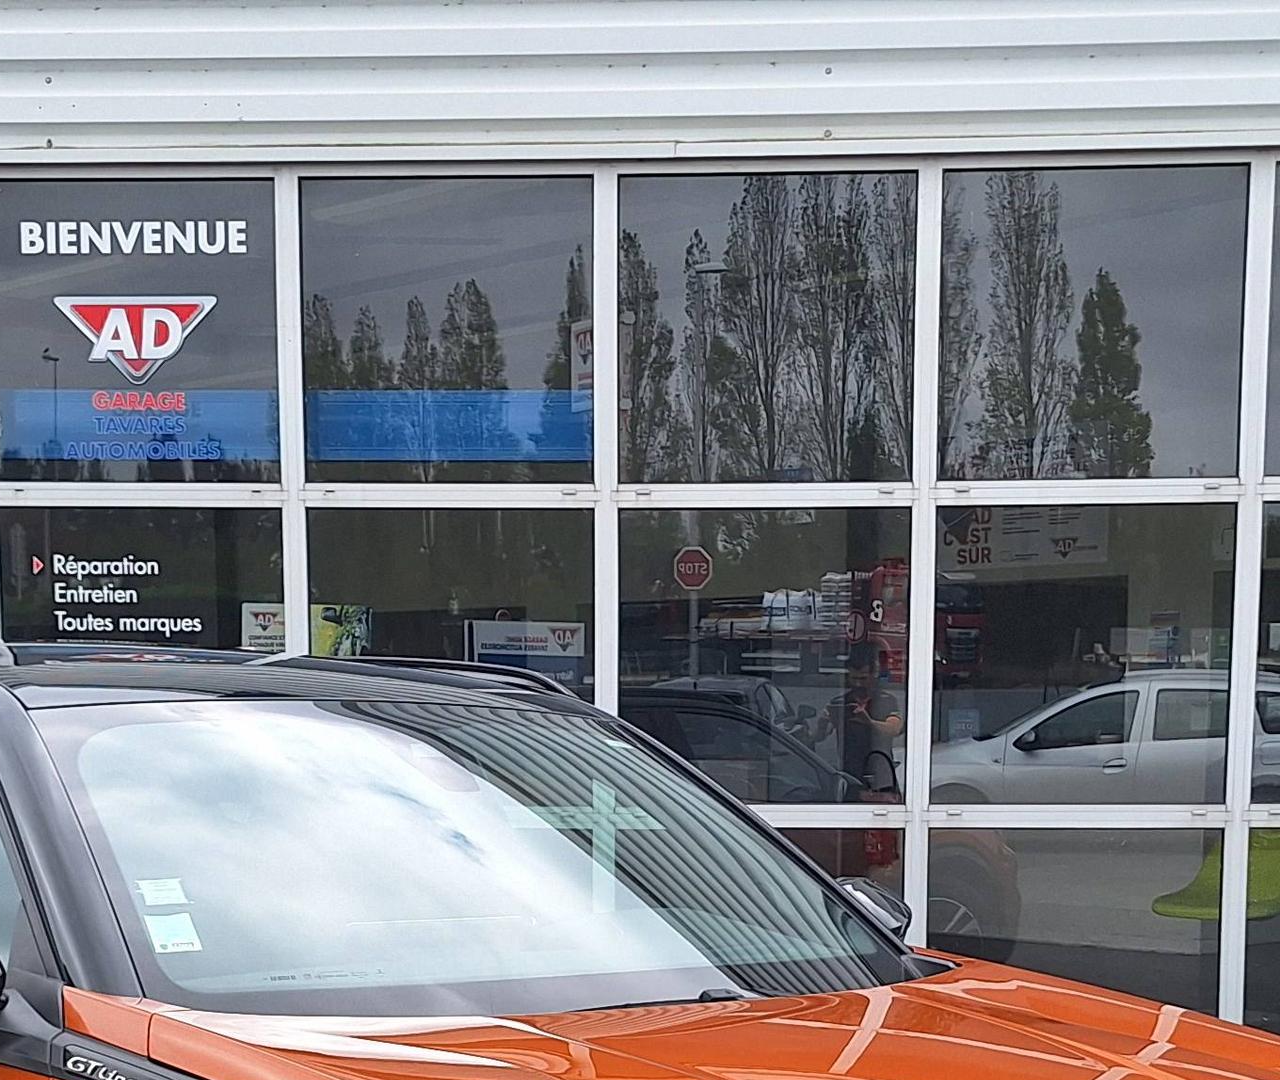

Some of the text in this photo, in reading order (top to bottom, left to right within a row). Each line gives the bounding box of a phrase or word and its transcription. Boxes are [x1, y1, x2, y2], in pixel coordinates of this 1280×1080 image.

[20, 220, 248, 254] BIENVENUE
[88, 308, 184, 362] AD
[91, 391, 186, 411] GARAGE
[94, 417, 187, 434] TAVARES
[64, 442, 221, 461] AUTOMOBILES
[944, 527, 992, 546] CST
[53, 555, 159, 580] Réparation
[54, 583, 138, 604] Entretien
[54, 611, 203, 638] Toutes marques
[257, 613, 274, 626] AD
